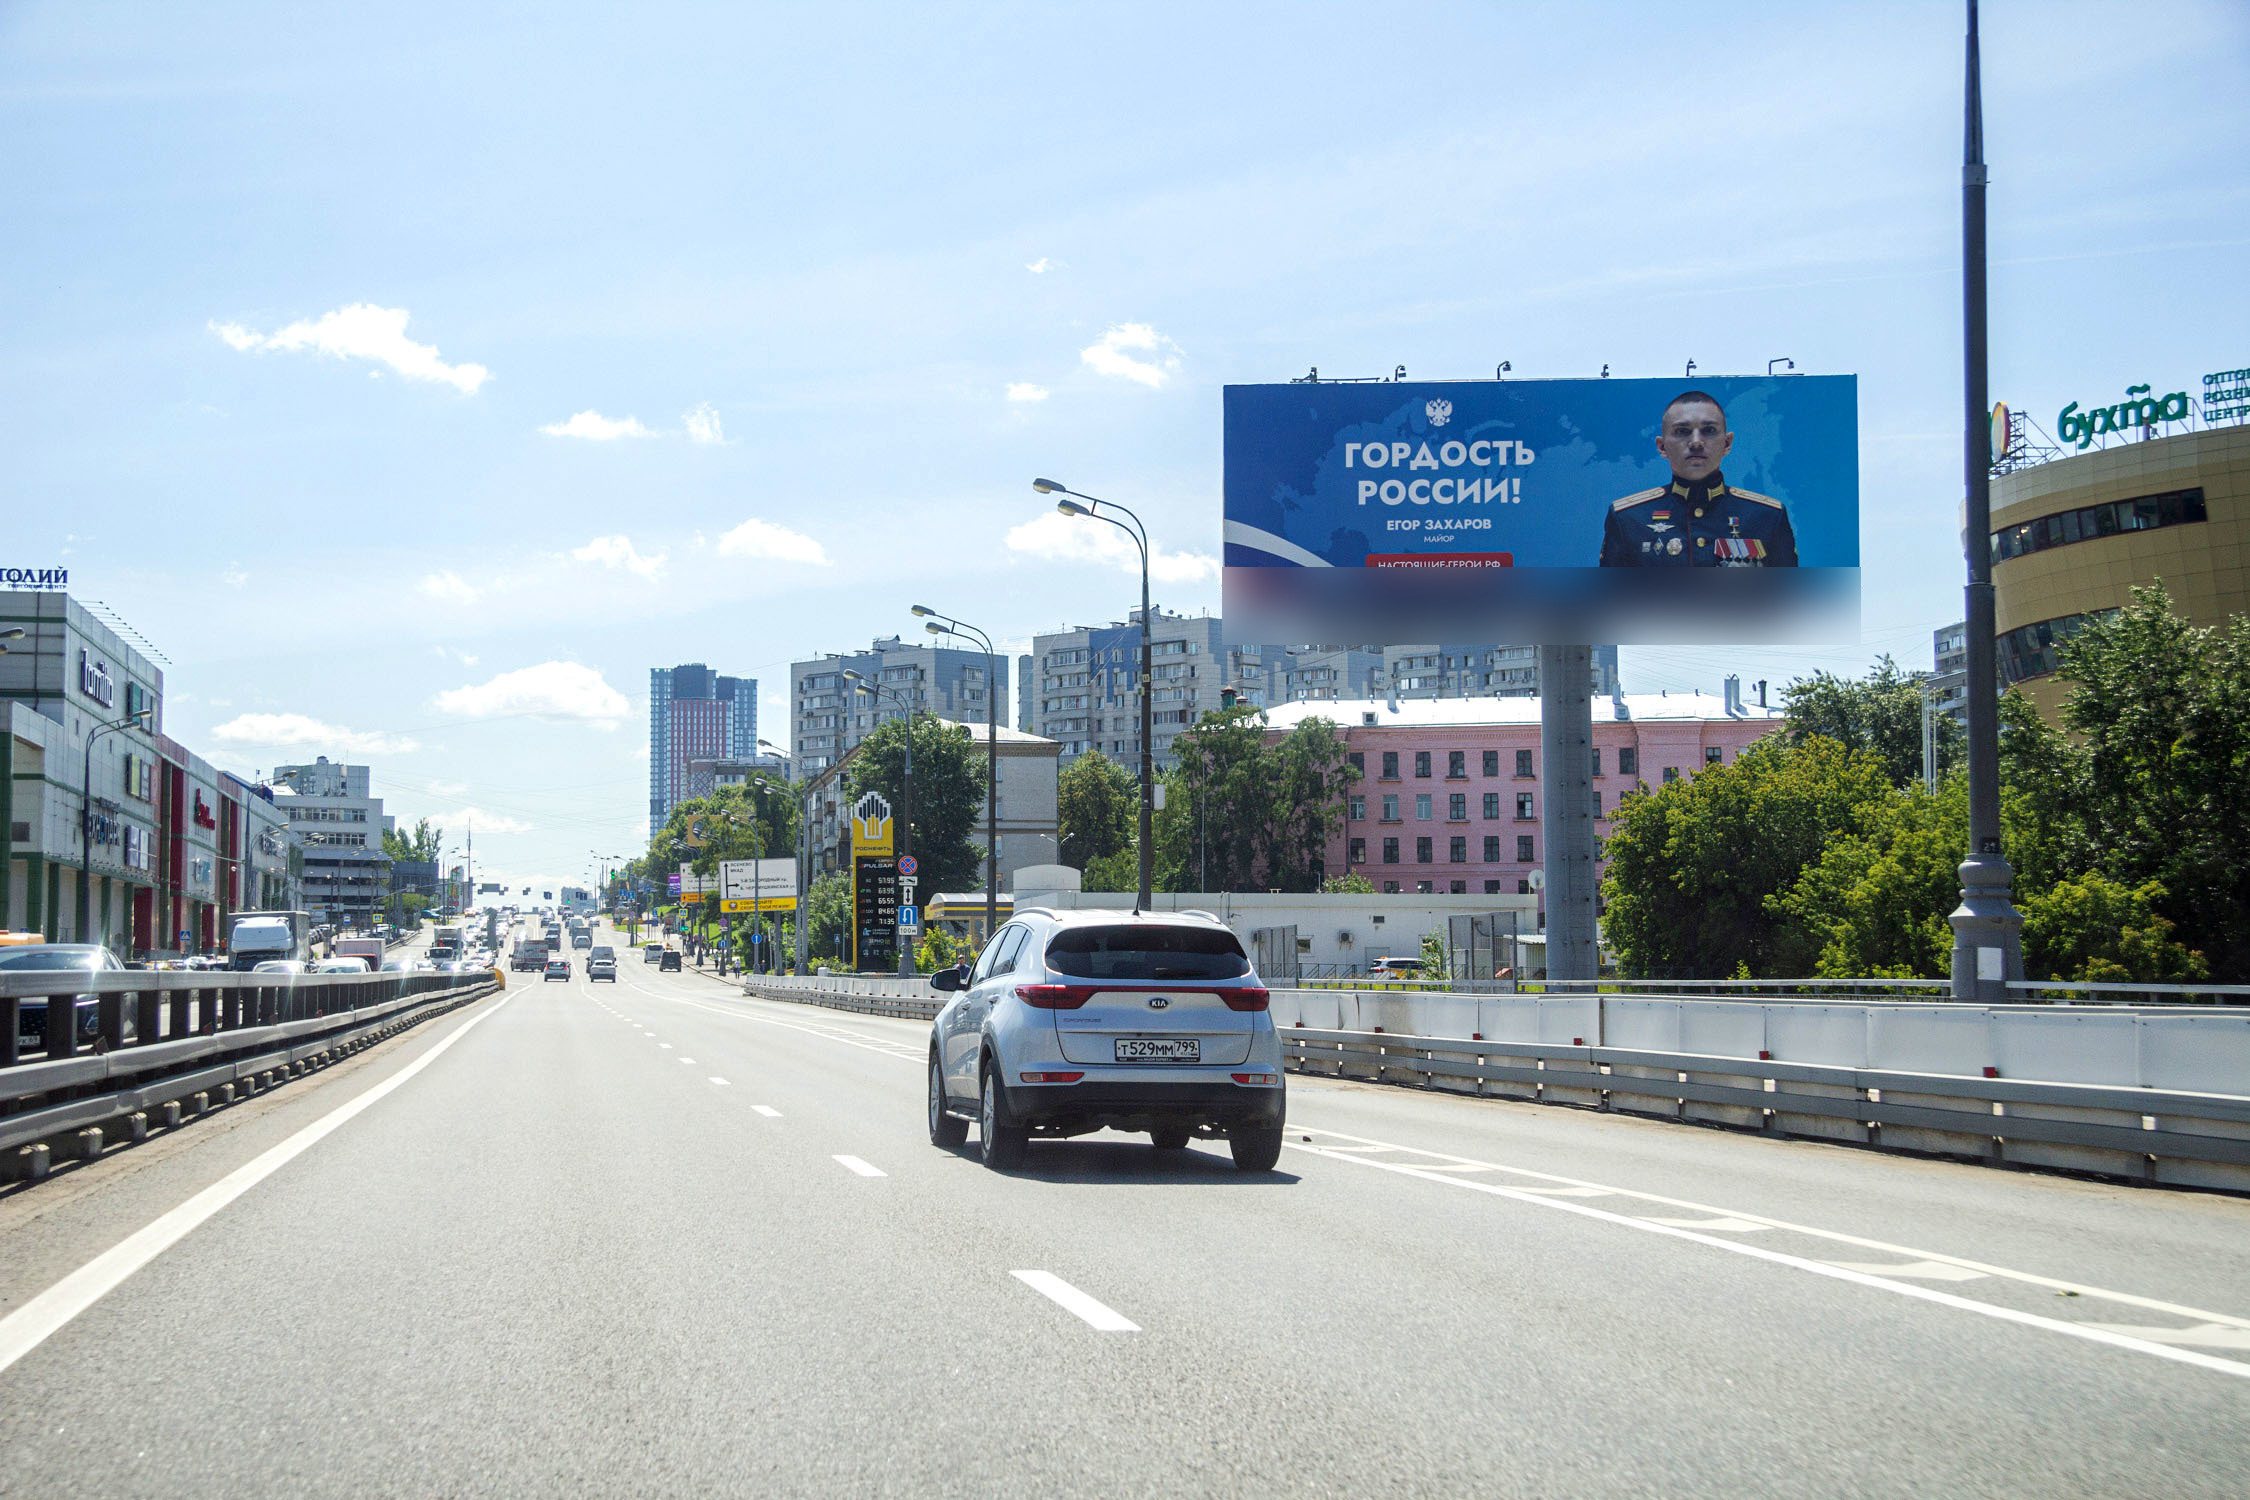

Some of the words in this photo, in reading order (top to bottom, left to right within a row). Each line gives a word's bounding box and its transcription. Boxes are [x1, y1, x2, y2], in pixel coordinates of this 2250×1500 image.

[2057, 384, 2187, 450] бухта
[1345, 440, 1536, 471] ГОРДОСТЬ
[1358, 477, 1521, 506] РОССИИ!
[1386, 519, 1421, 531] ЕГОР
[1424, 518, 1492, 530] ЗАХАРОВ
[1423, 534, 1455, 543] МАЙОР
[1151, 1000, 1167, 1008] KIA
